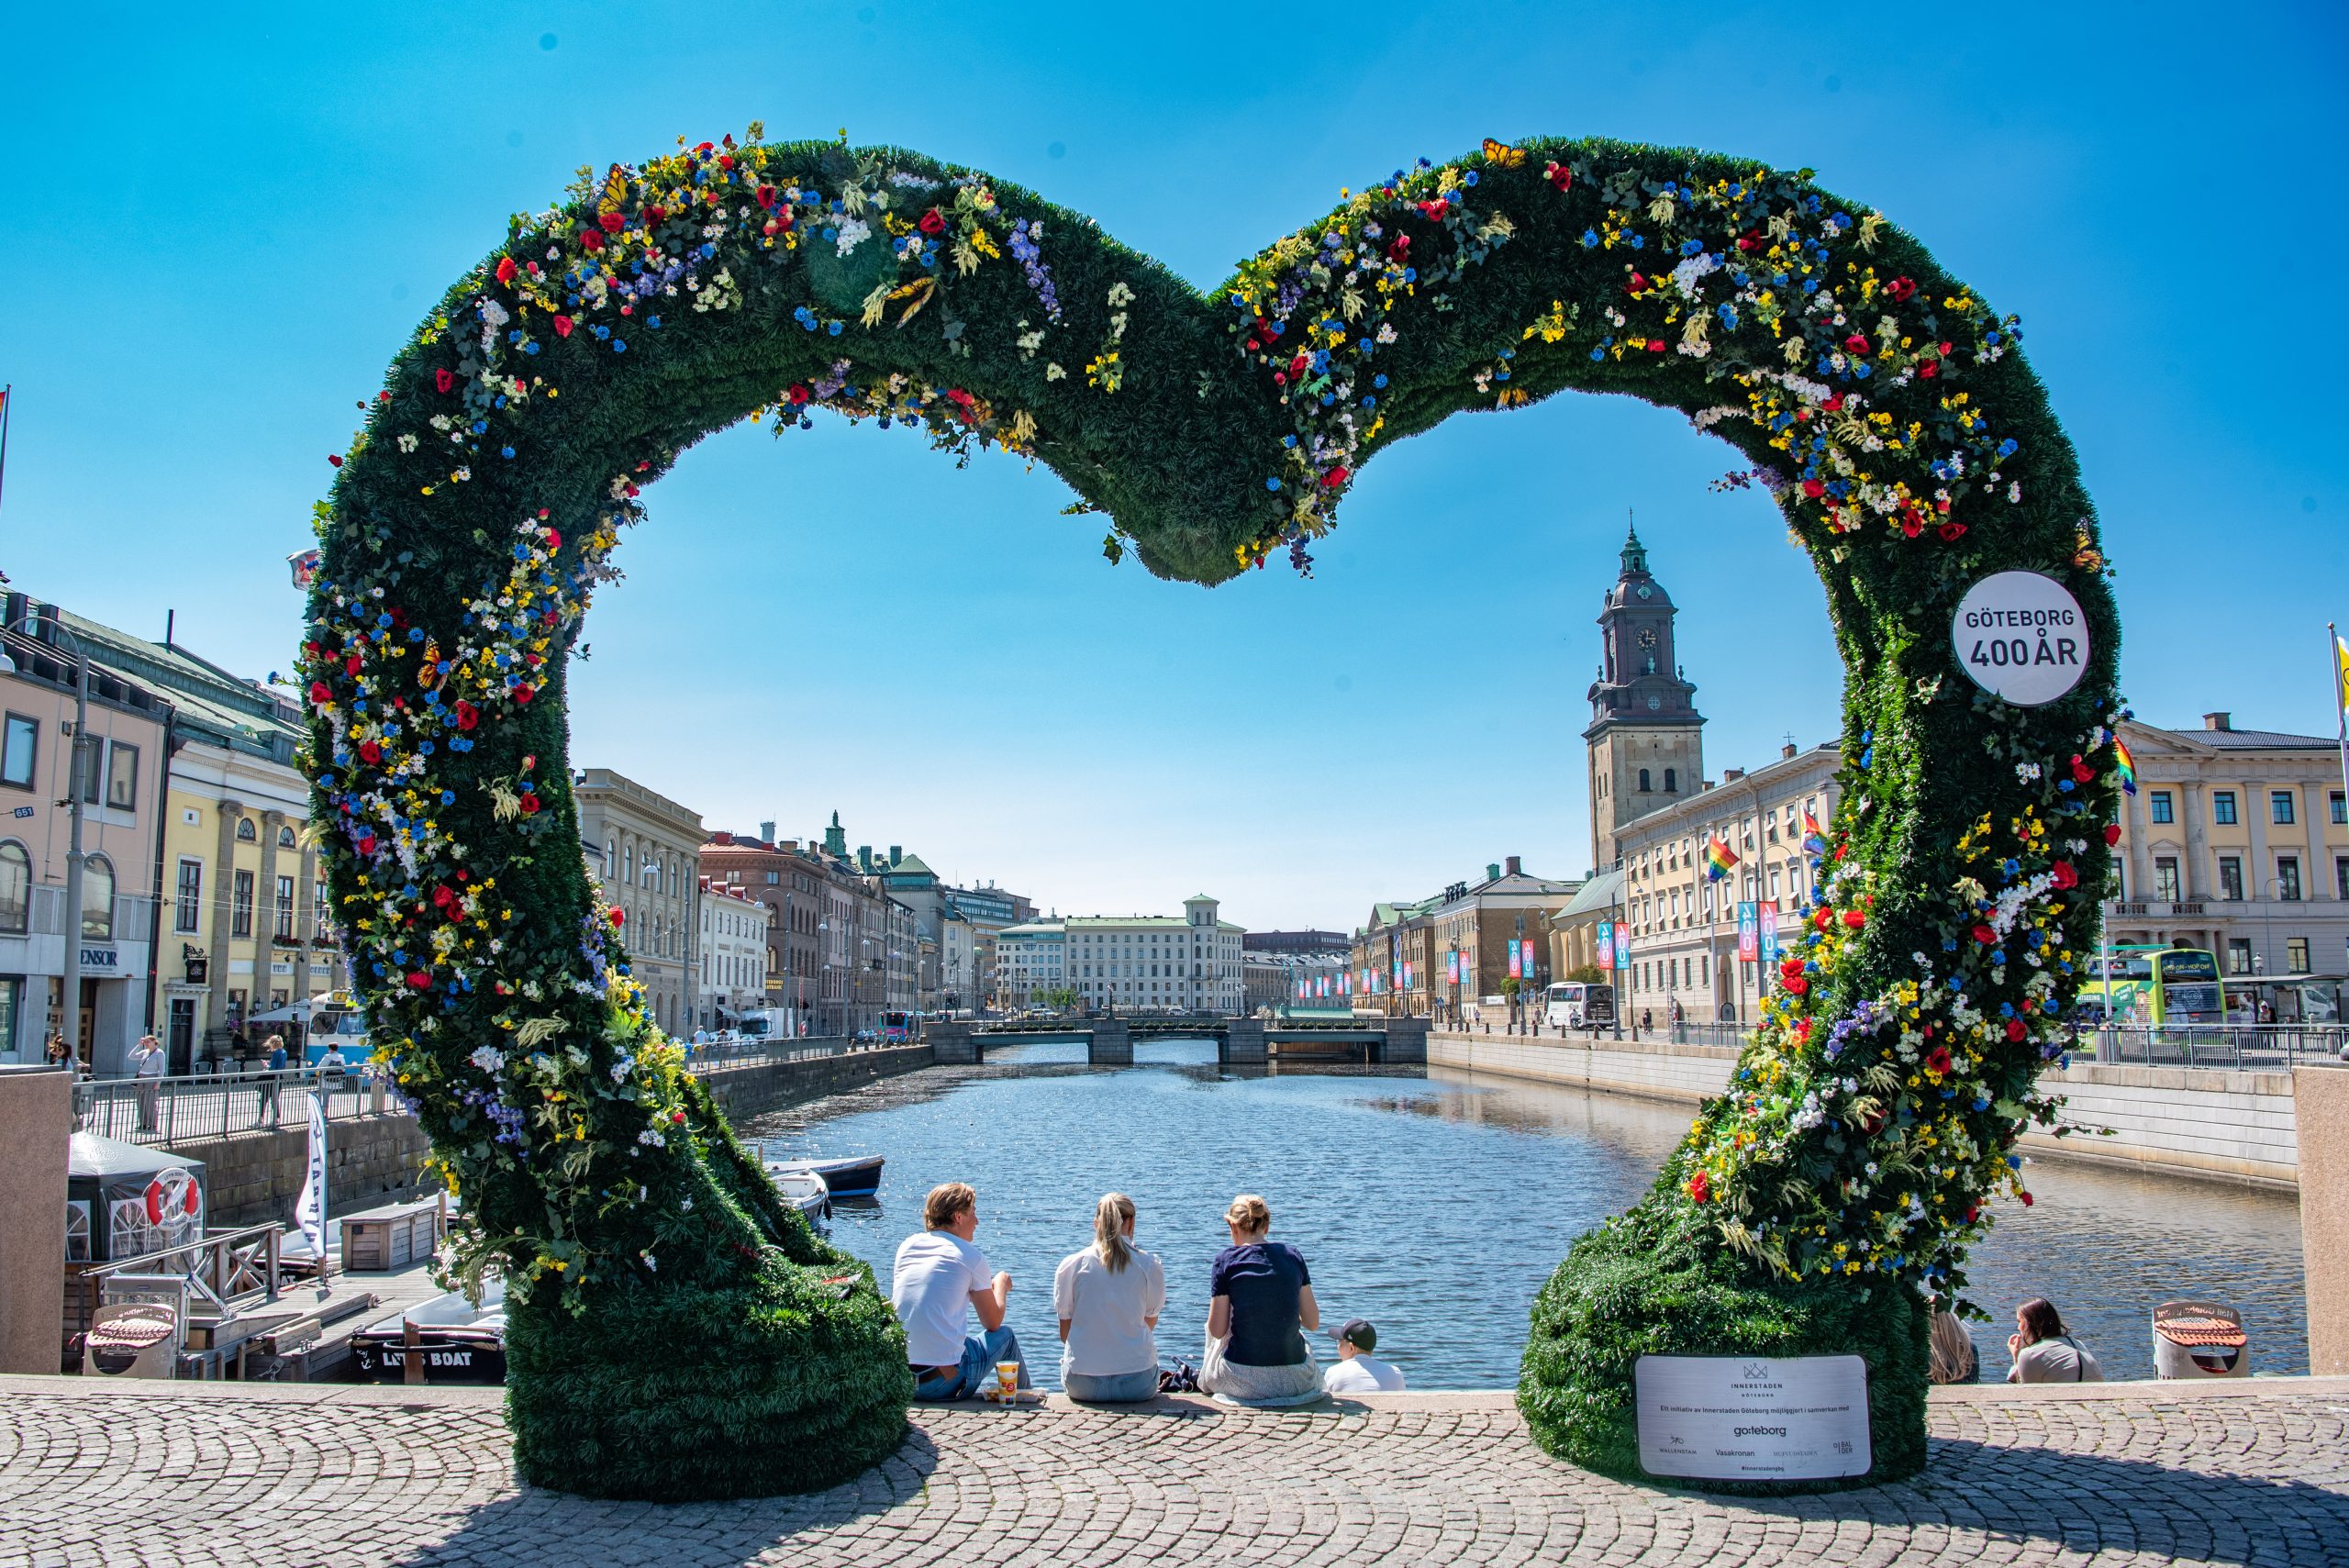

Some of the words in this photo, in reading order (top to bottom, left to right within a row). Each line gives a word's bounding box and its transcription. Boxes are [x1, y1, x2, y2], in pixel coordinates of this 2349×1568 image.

[1965, 607, 2074, 628] GÖTEBORG
[1970, 639, 2029, 666] 400
[2033, 628, 2078, 665] ÅR
[16, 807, 33, 817] 651
[430, 1352, 472, 1366] BOAT
[1770, 1407, 1803, 1415] möjliggjort
[1733, 1426, 1787, 1438] go:teborg
[1659, 1447, 1698, 1455] WALLENSTAM
[1715, 1449, 1755, 1457] Vasakronan
